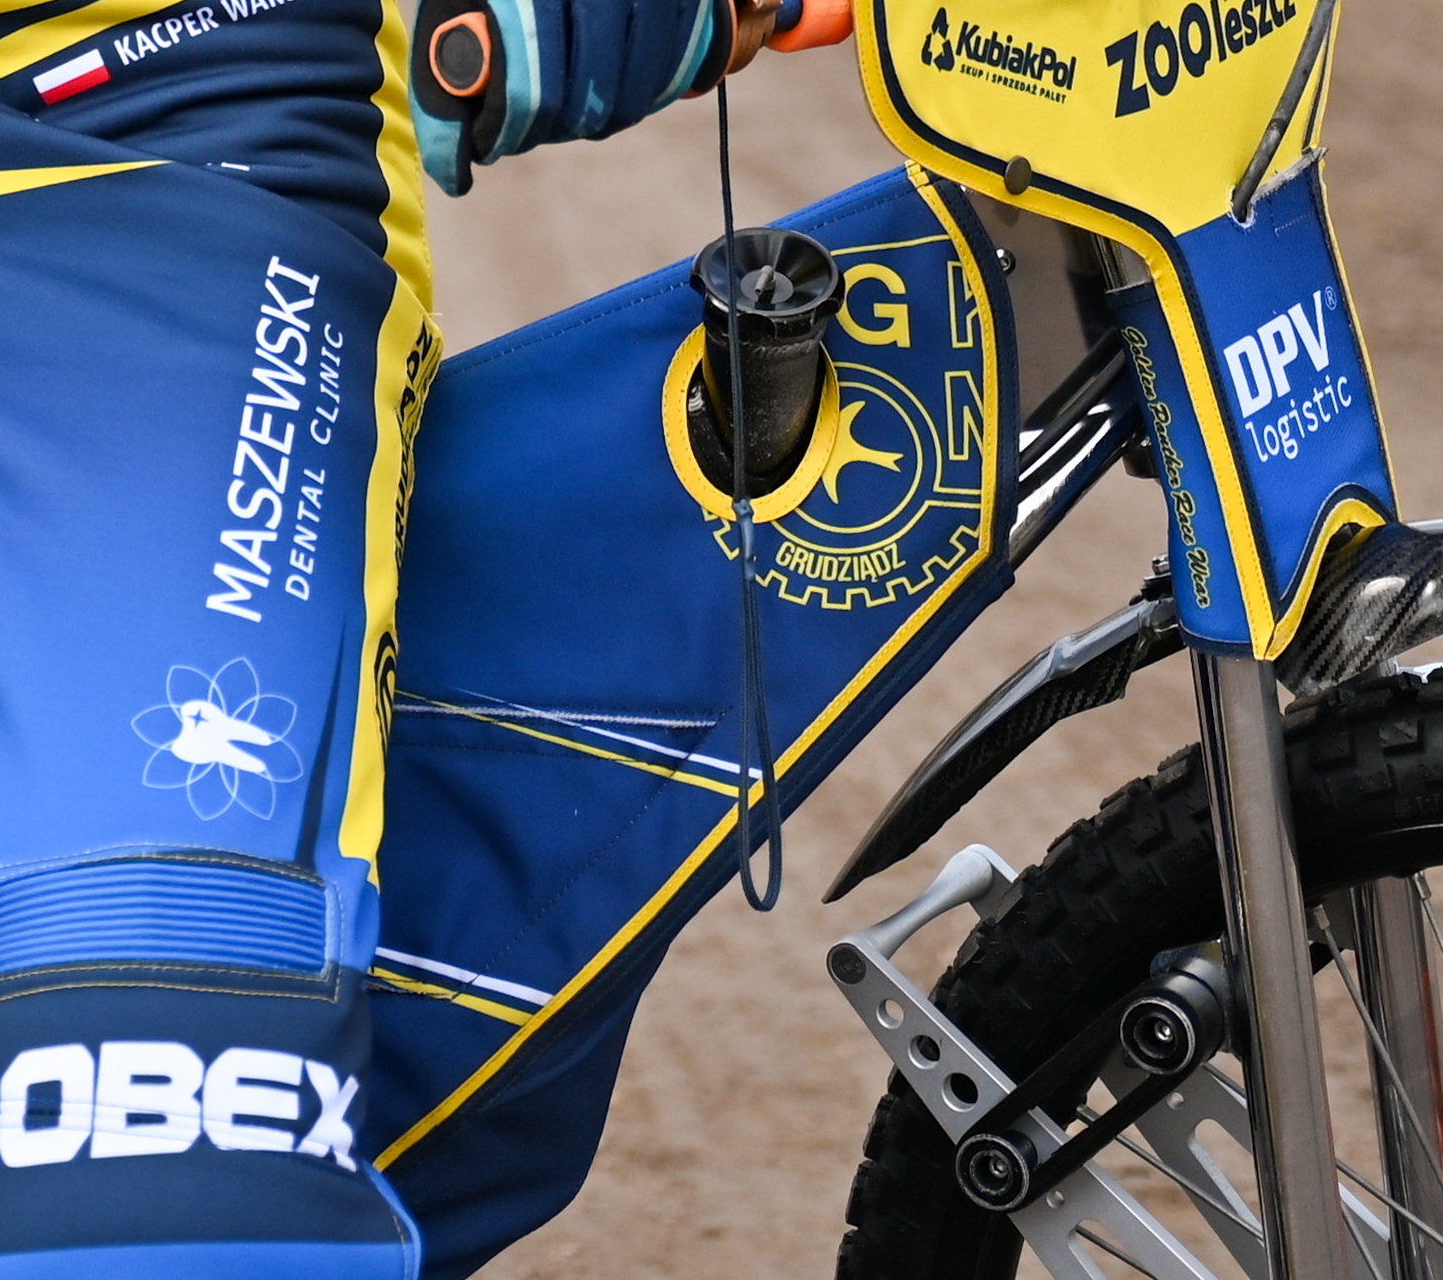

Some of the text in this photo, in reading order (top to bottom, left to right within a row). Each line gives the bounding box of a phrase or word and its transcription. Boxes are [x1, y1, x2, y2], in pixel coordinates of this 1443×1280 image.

[114, 6, 219, 67] KACPER
[955, 21, 1076, 91] KubiakPol
[959, 64, 982, 80] SKUP
[991, 72, 1038, 97] SPRZEDAŻ
[1039, 85, 1067, 104] PALET
[205, 255, 320, 623] MASZEWSKI
[1245, 374, 1351, 462] logistic
[284, 322, 344, 601] DENTAL CLINIC
[775, 541, 906, 583] GRUDZIĄDZ
[1171, 490, 1196, 546] Race
[1187, 548, 1210, 609] Wear
